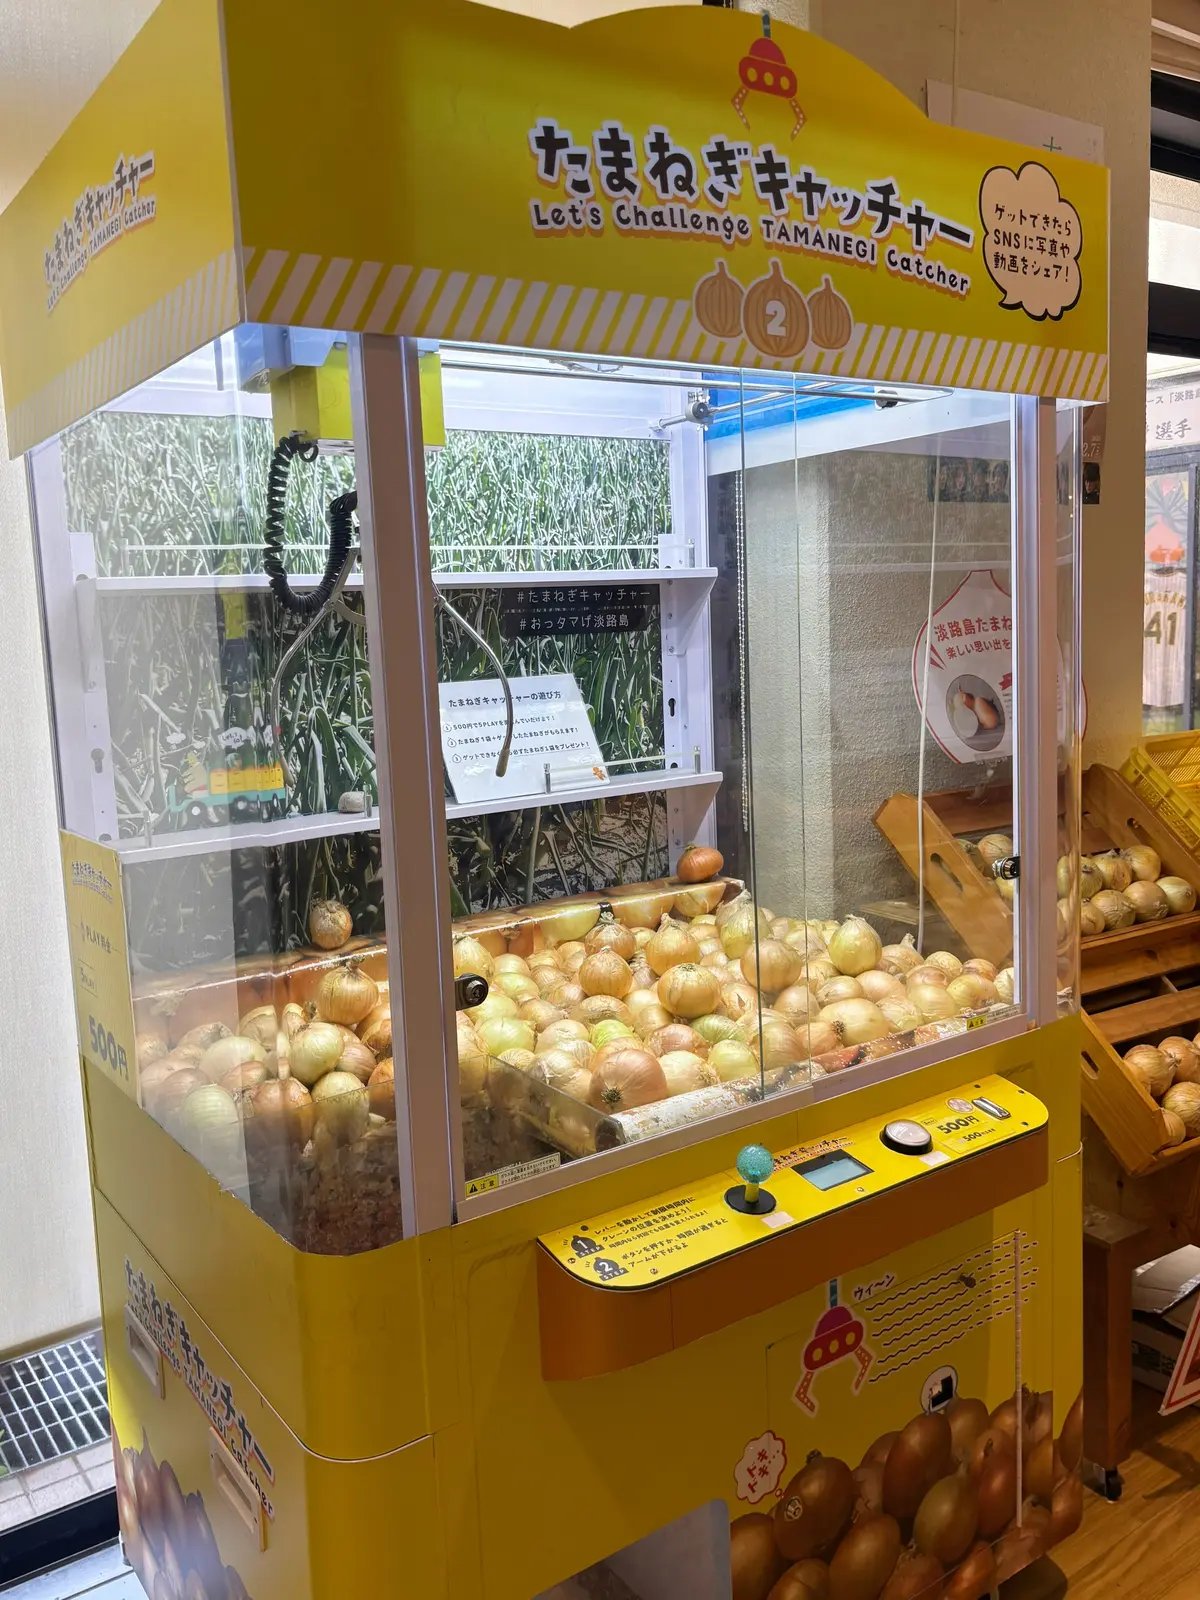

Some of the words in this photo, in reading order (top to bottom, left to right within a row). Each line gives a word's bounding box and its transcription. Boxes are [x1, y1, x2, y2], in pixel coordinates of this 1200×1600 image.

[535, 126, 970, 246] たまねぎキャッチャー
[45, 159, 153, 282] たまねぎキャッチャー
[89, 215, 122, 253] TAMANEGI
[124, 200, 155, 226] Catcher
[995, 204, 1071, 236] ゲットできたら
[534, 201, 601, 225] Let's
[616, 205, 749, 239] Challenge
[762, 219, 876, 261] TAMANEGI
[887, 249, 968, 292] Catcher
[994, 229, 1070, 258] SNSに写真や
[994, 252, 1069, 282] 動画をシェア！
[765, 301, 786, 336] 2
[517, 589, 651, 603] #たまねぎキャッチャー
[519, 614, 630, 630] #おっタマげ淡路島
[1144, 611, 1177, 645] 41
[449, 691, 562, 708] たまねぎキャッャーの遊び方
[89, 1014, 129, 1081] 500円
[937, 1115, 980, 1134] 500円
[577, 1239, 588, 1249] 1
[599, 1261, 614, 1272] 2
[126, 1259, 272, 1476] たまねぎキャッチャー
[183, 1365, 227, 1439] TAMANEGI
[231, 1438, 273, 1514] Catcher
